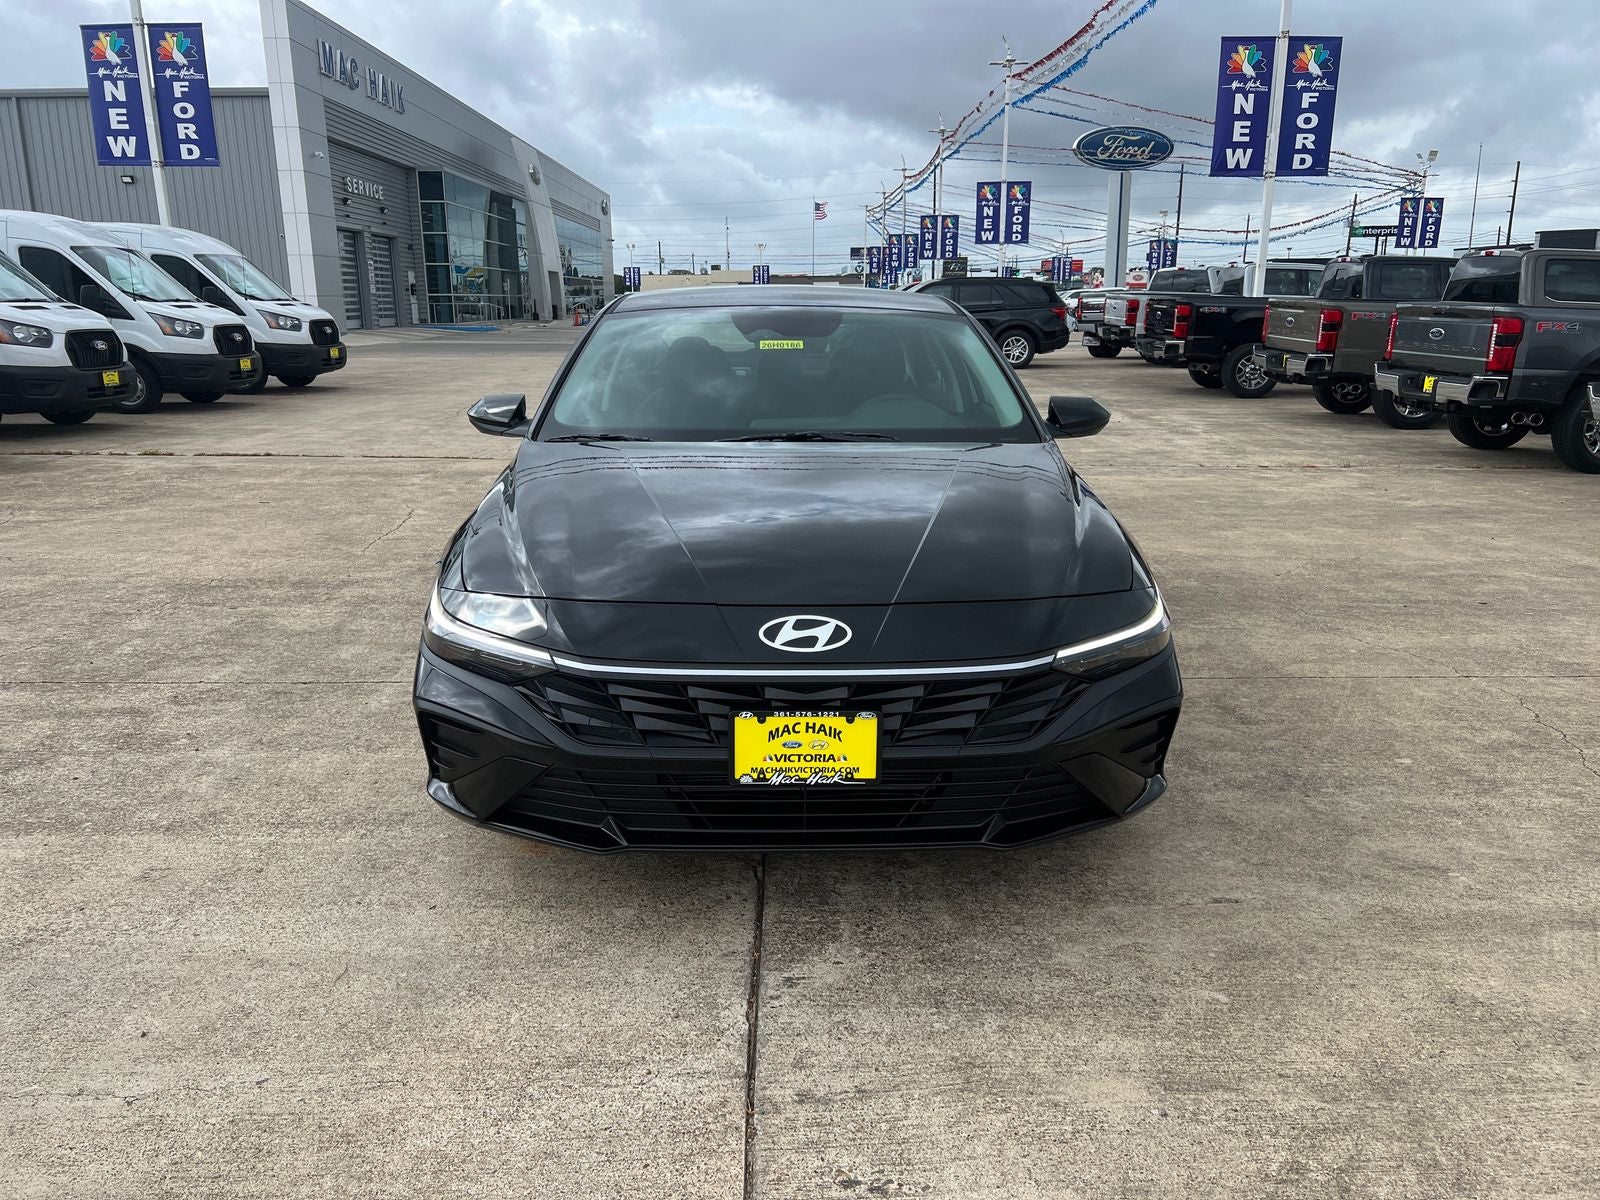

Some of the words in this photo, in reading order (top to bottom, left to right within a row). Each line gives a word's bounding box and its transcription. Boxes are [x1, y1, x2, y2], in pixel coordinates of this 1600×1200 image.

[317, 38, 360, 90] MAC
[365, 65, 406, 114] HAIK
[103, 80, 136, 158] NEW
[172, 81, 201, 160] FORD
[1225, 93, 1255, 169] NEW
[1292, 92, 1320, 170] FORD
[1096, 134, 1155, 160] Ford
[346, 176, 385, 200] SERVICE
[981, 206, 994, 241] NEW
[1012, 206, 1023, 241] FORD
[1355, 226, 1398, 236] enterpris
[1400, 217, 1413, 246] NEW
[1424, 217, 1436, 246] FORD
[891, 247, 899, 267] NEW
[907, 247, 915, 267] FORD
[923, 232, 933, 258] NEW
[945, 232, 954, 258] FORD
[1536, 321, 1579, 332] FX4
[768, 722, 801, 743] MAC
[805, 722, 843, 743] HAIK
[774, 753, 837, 763] VICTORIA
[767, 771, 805, 785] Mac
[806, 771, 845, 785] Haik
